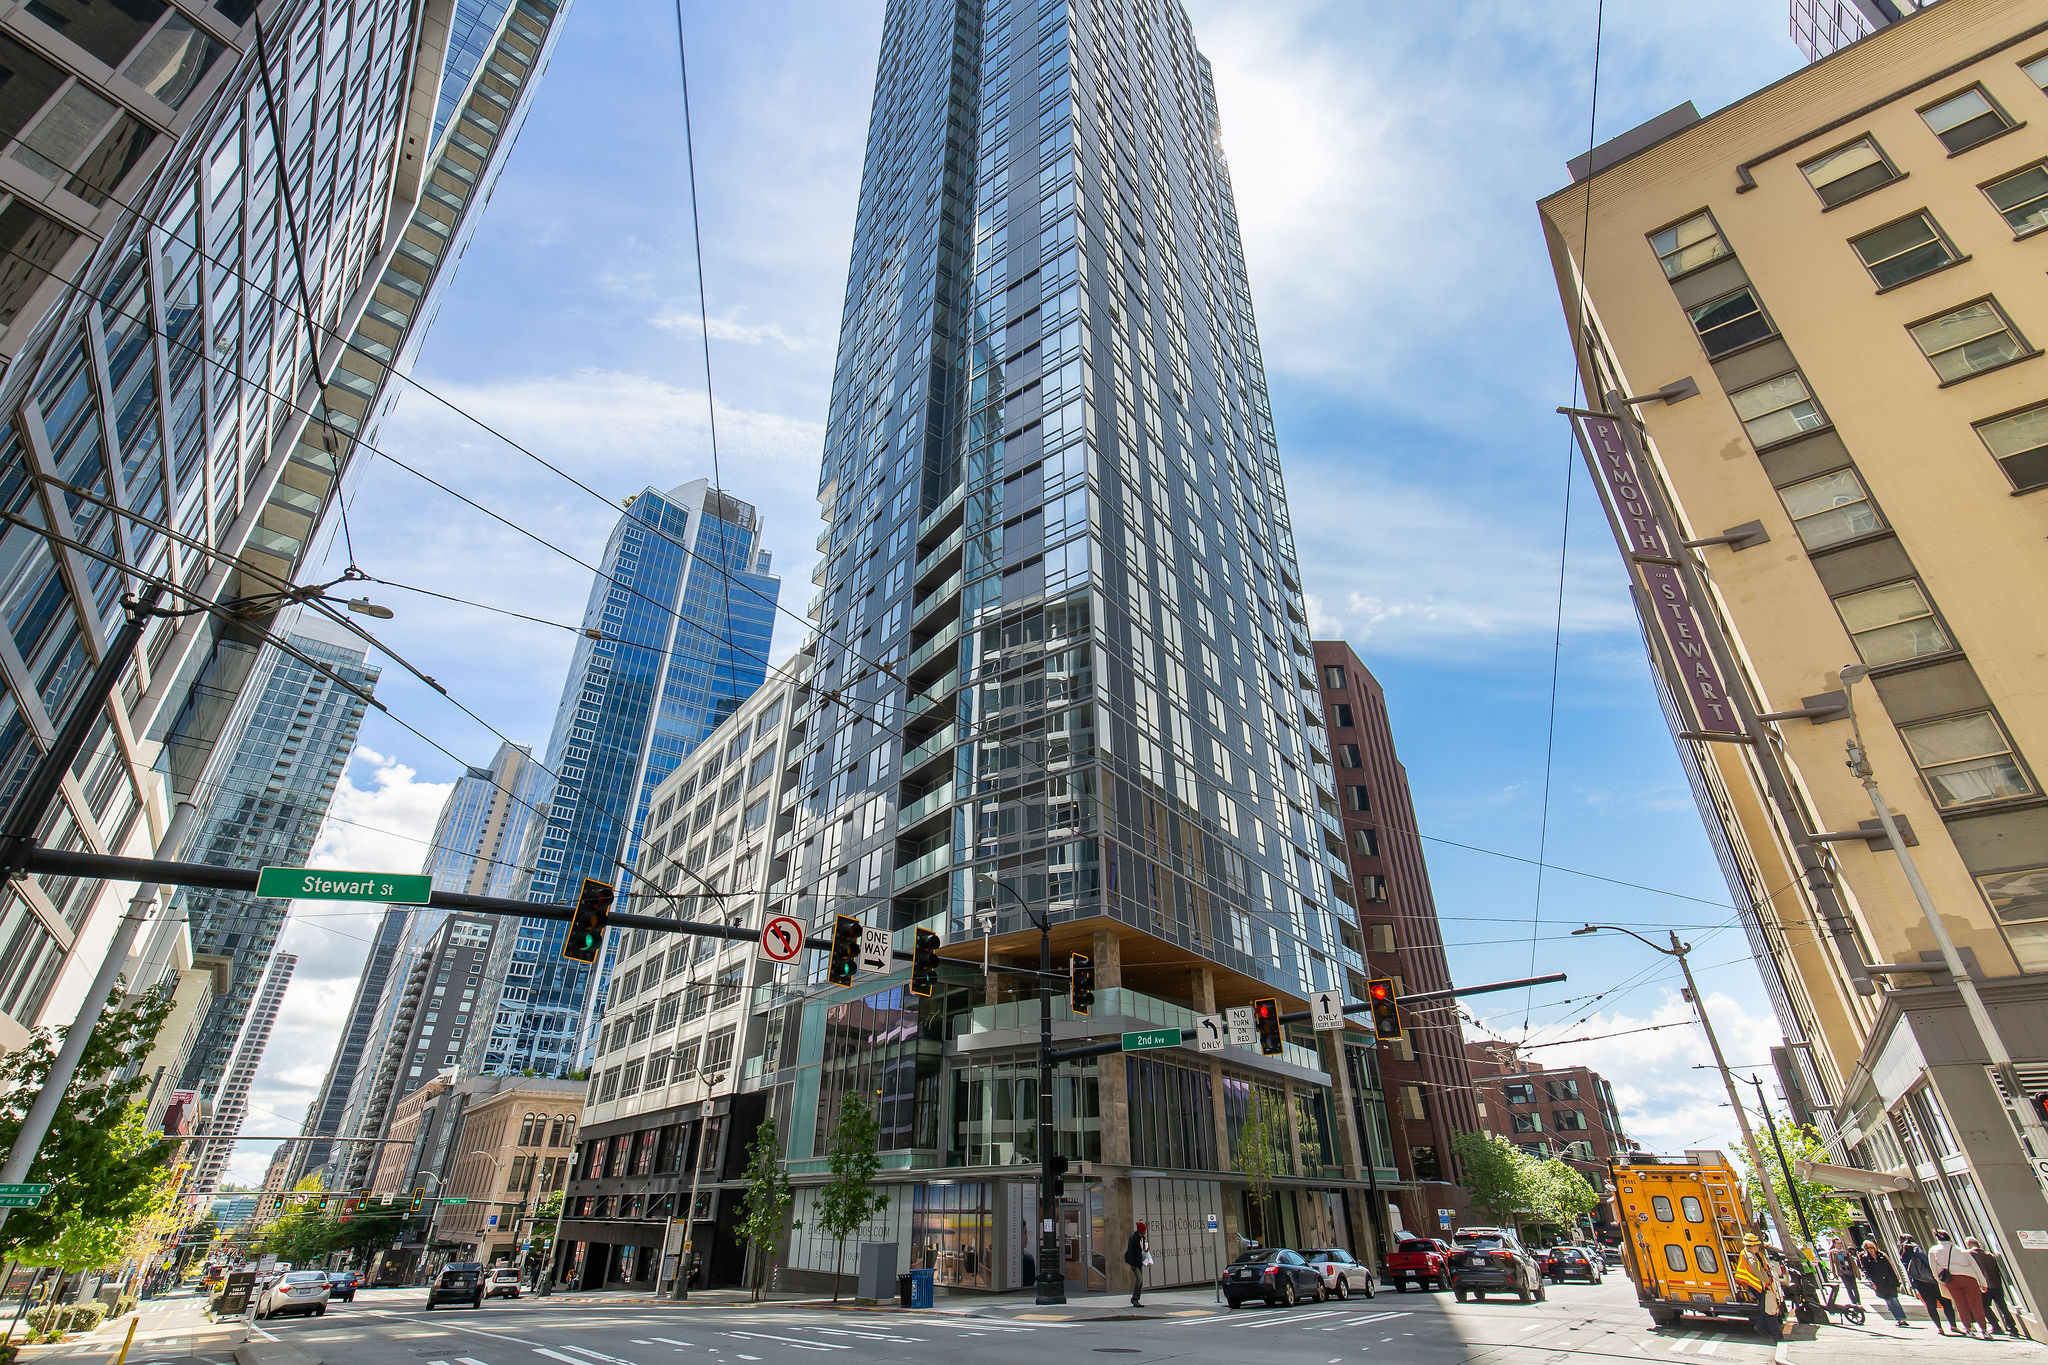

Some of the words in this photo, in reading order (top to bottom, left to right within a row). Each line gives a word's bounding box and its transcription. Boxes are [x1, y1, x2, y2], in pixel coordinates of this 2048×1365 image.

[1597, 425, 1657, 550] PLYMOUTH
[1661, 583, 1724, 721] STEWART
[292, 876, 375, 895] Stewart
[380, 884, 393, 896] St
[866, 930, 888, 945] ONE
[864, 942, 888, 957] WAY
[1233, 1010, 1246, 1018] NO
[1317, 1014, 1338, 1022] ONLY
[1137, 1035, 1152, 1046] 2nd
[1154, 1036, 1165, 1044] Ave
[1201, 1041, 1221, 1049] ONLY
